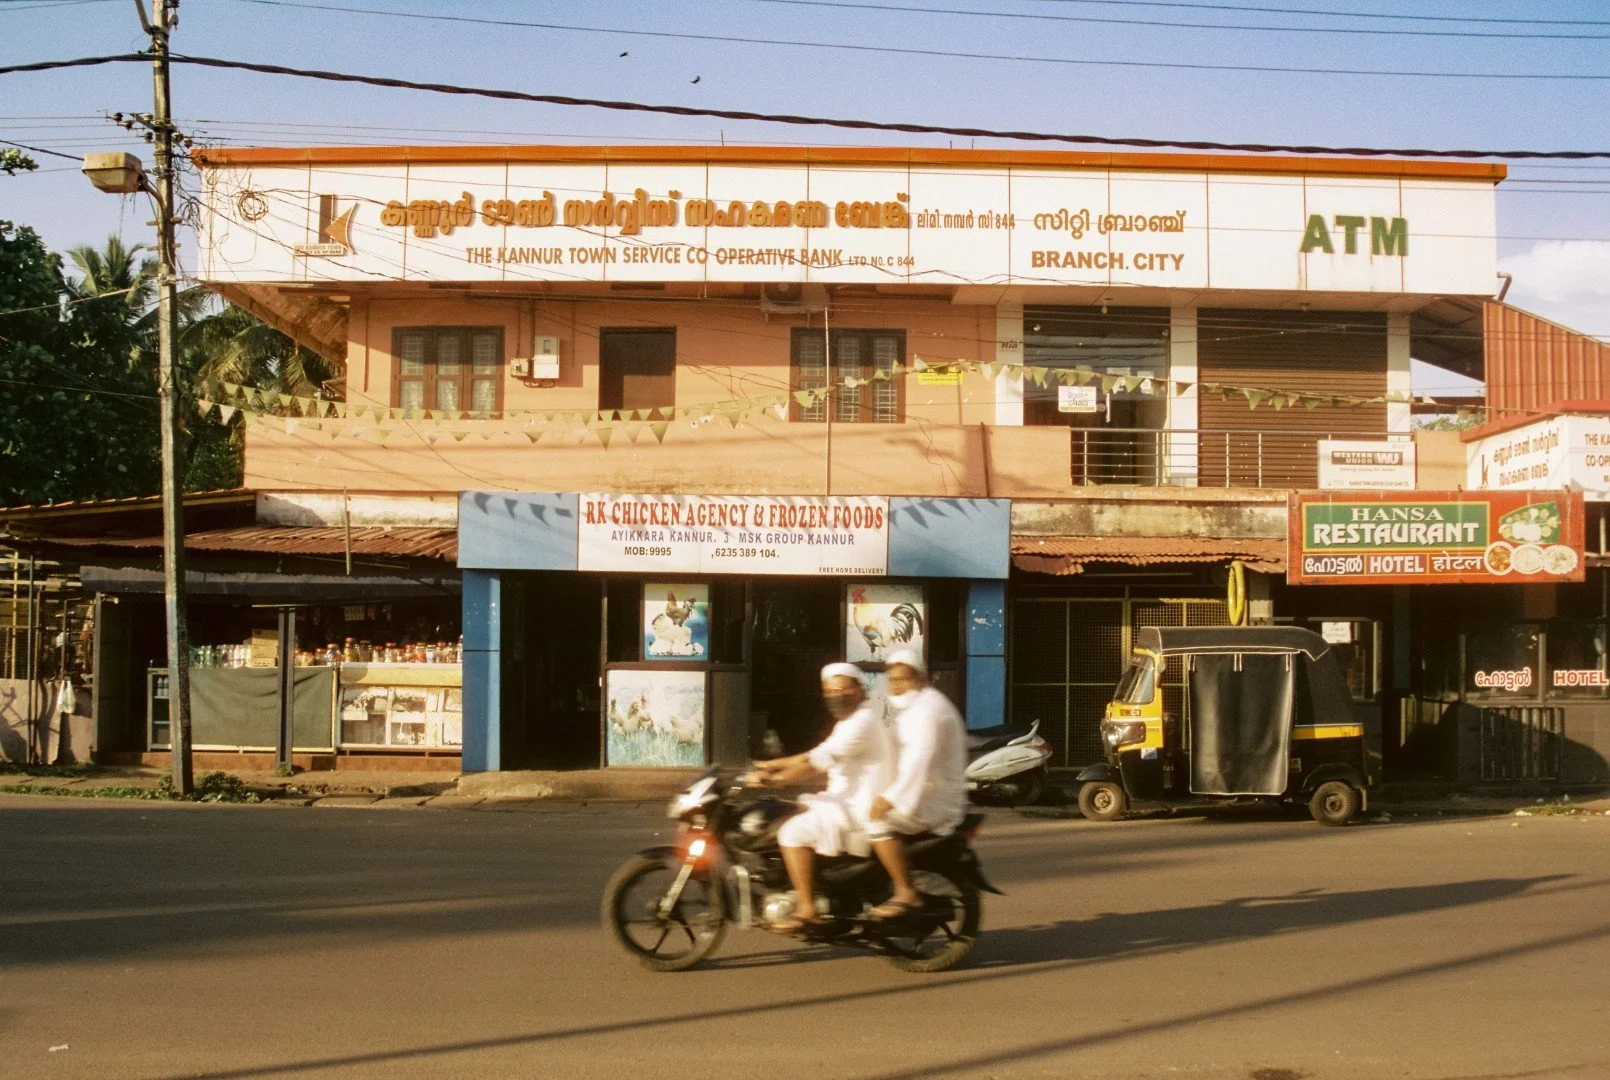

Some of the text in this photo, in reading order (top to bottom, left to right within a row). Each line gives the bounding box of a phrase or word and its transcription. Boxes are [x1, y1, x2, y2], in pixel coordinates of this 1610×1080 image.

[995, 214, 1016, 229] 844
[1034, 208, 1090, 240] സിറ്റി
[1300, 214, 1408, 256] ATM
[466, 248, 843, 266] THE KANNUR TOWN SERVICE CO OPERATIVE BANK
[887, 256, 894, 266] C
[897, 256, 915, 266] 844
[1133, 252, 1184, 271] CITY
[1585, 434, 1598, 445] THE
[586, 502, 883, 529] RK CHICKEN AGENCY & FROZEN FOODS
[1351, 508, 1444, 521] HANSA
[612, 530, 664, 542] AYIKKARA
[724, 532, 729, 543] 3
[739, 533, 762, 544] MSK
[766, 533, 804, 544] GROUP
[808, 534, 855, 545] KANNUR
[1313, 523, 1480, 546] RESTAURANT
[740, 549, 756, 557] 389
[1431, 551, 1484, 573] होटल
[1305, 556, 1362, 575] ഹോട്ടൽ
[1370, 556, 1424, 574] HOTEL
[1475, 667, 1531, 691] ഹോട്ടൽ
[1554, 670, 1610, 686] HOTEL
